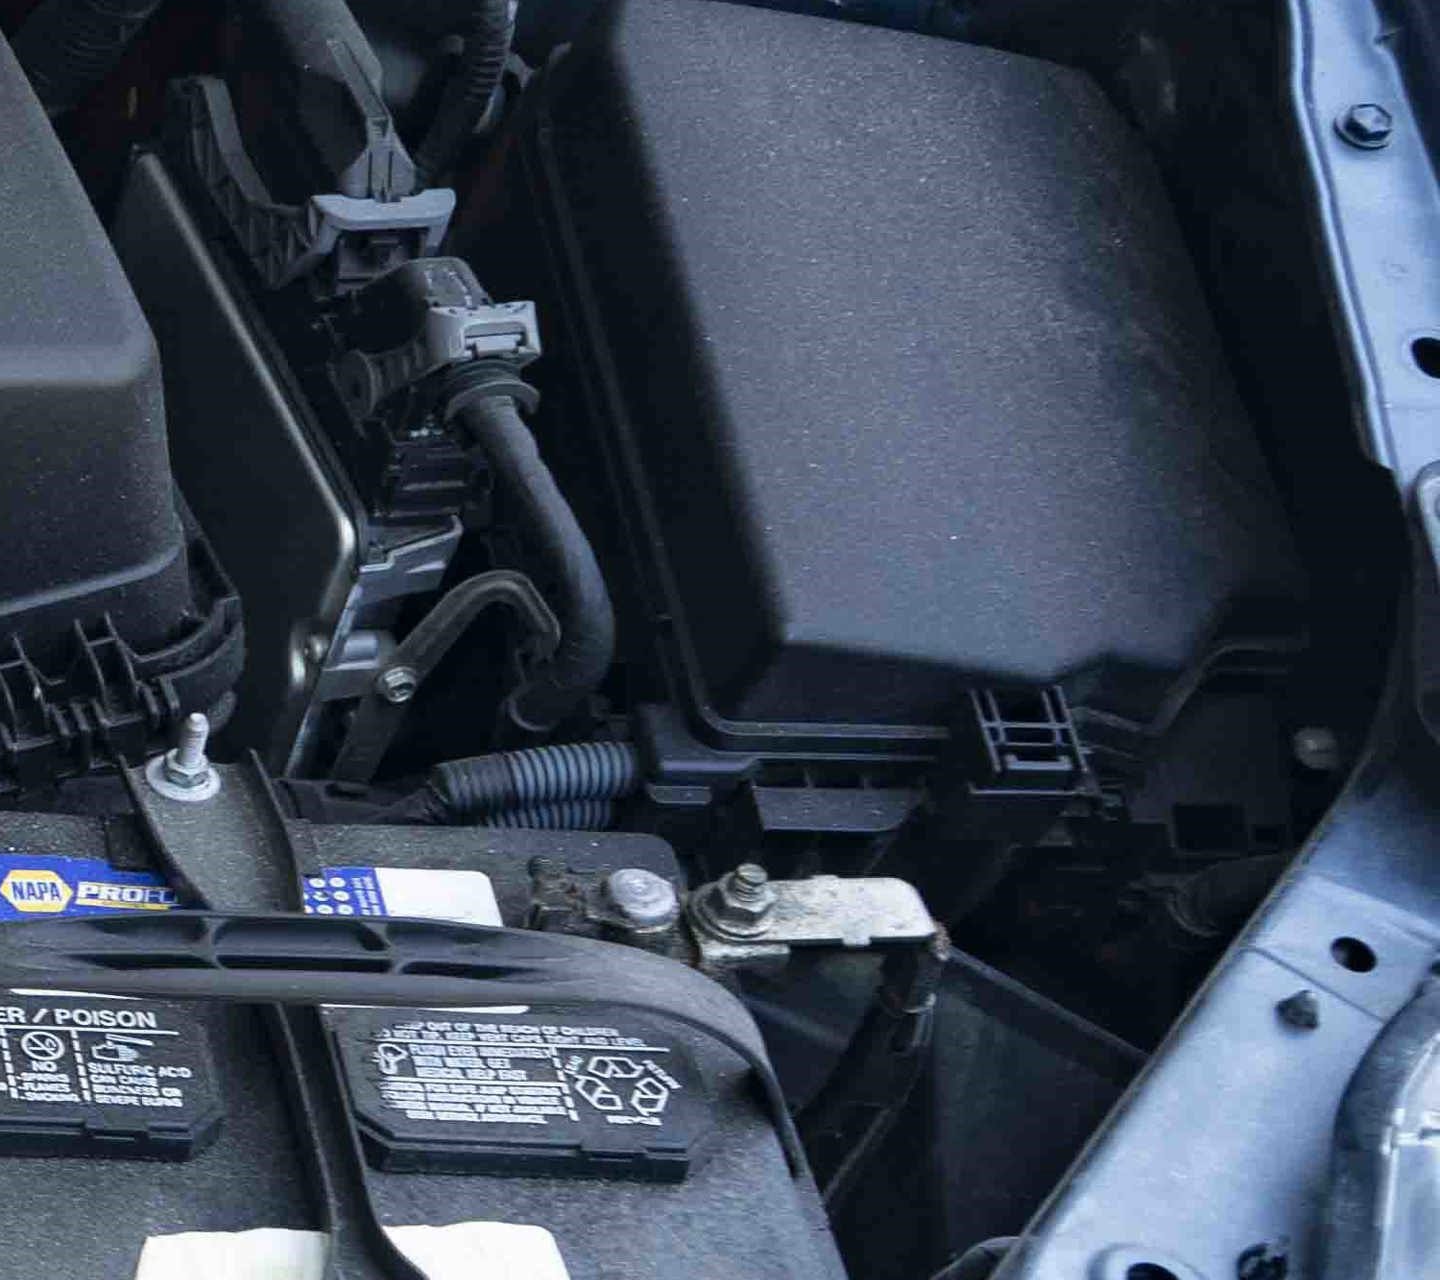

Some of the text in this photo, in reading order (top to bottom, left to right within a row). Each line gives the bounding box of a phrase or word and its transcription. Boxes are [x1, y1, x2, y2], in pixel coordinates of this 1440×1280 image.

[11, 880, 63, 903] NAPA
[54, 1008, 157, 1028] POISON
[32, 1060, 57, 1072] NO
[86, 1062, 155, 1076] SULFURIC
